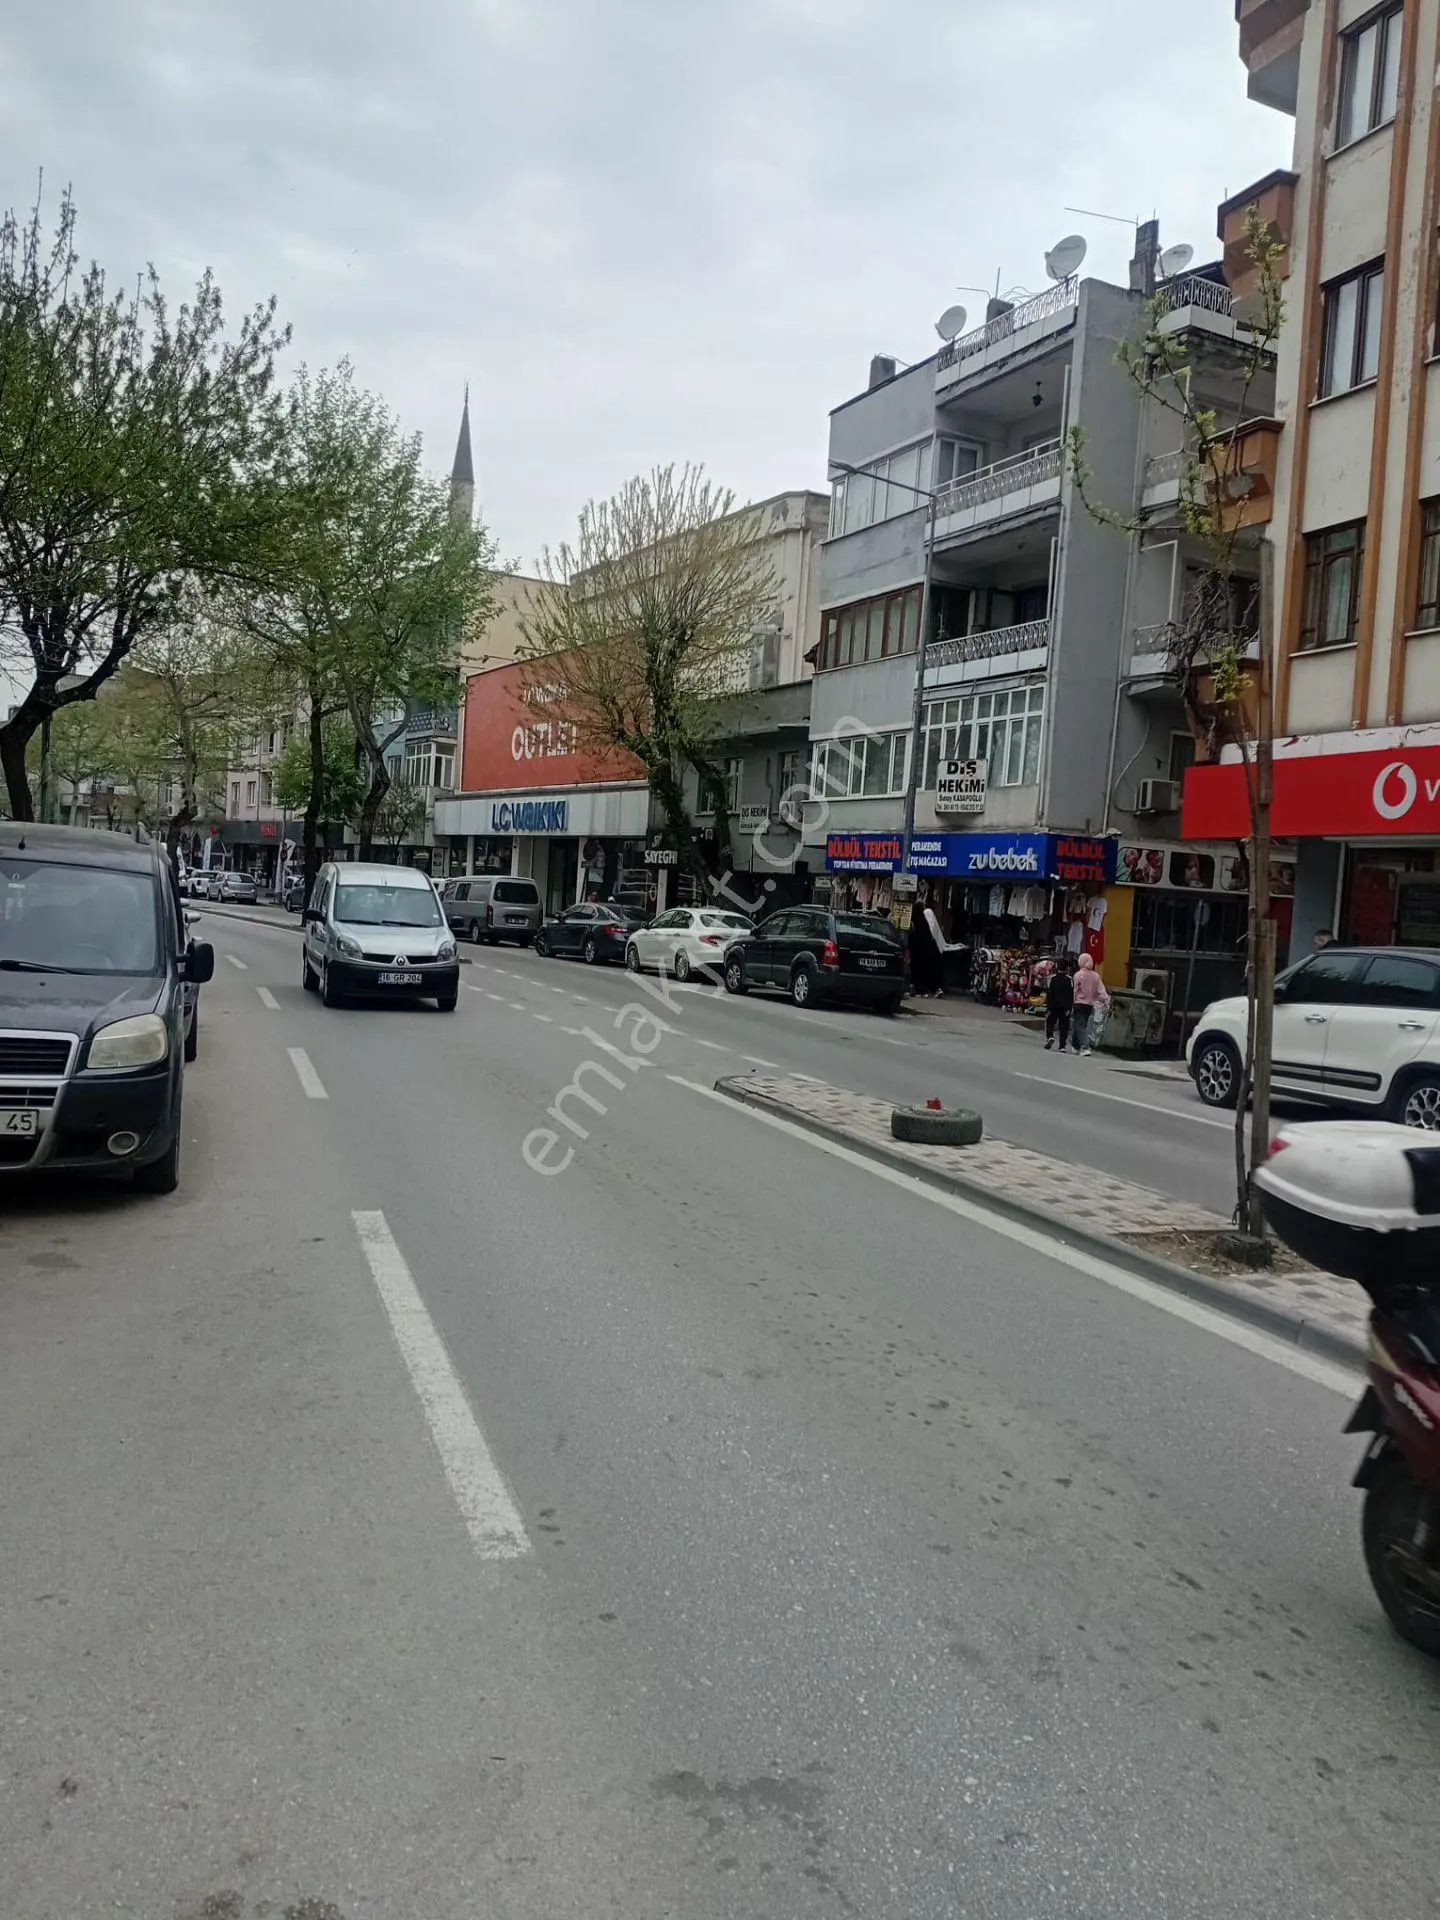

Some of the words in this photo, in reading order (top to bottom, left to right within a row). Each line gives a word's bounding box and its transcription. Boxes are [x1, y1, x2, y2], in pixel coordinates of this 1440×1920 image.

[511, 721, 577, 761] OUTLET
[828, 836, 861, 858] BÜLBÜL
[863, 837, 901, 859] TEKSTİL
[1056, 837, 1106, 860] BÜLBÜL
[1056, 862, 1106, 882] TEKSTİL
[6, 1113, 32, 1131] 45
